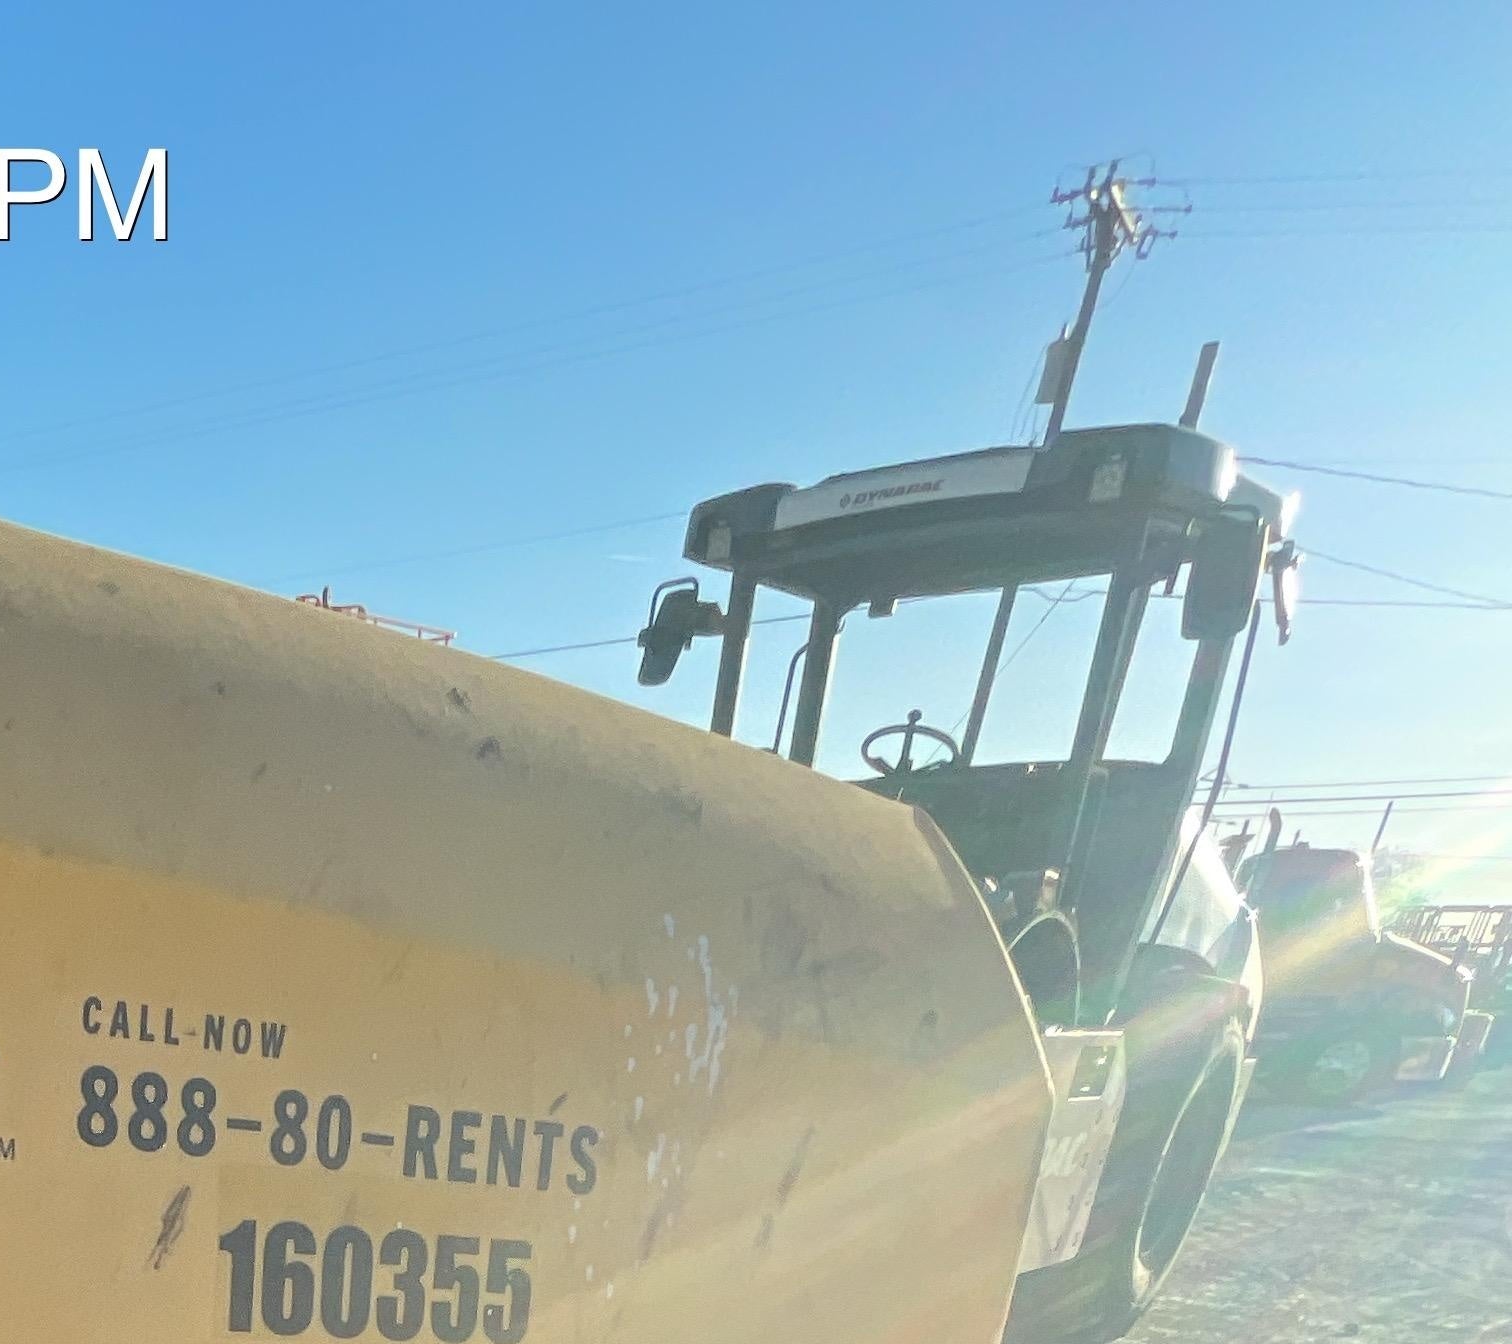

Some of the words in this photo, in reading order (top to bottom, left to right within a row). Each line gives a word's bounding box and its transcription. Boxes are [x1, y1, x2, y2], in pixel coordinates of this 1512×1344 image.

[854, 479, 946, 504] DYNAPAC
[80, 994, 182, 1048] CALL
[201, 1012, 289, 1062] NOW
[76, 1064, 600, 1197] 888-80-RENTS
